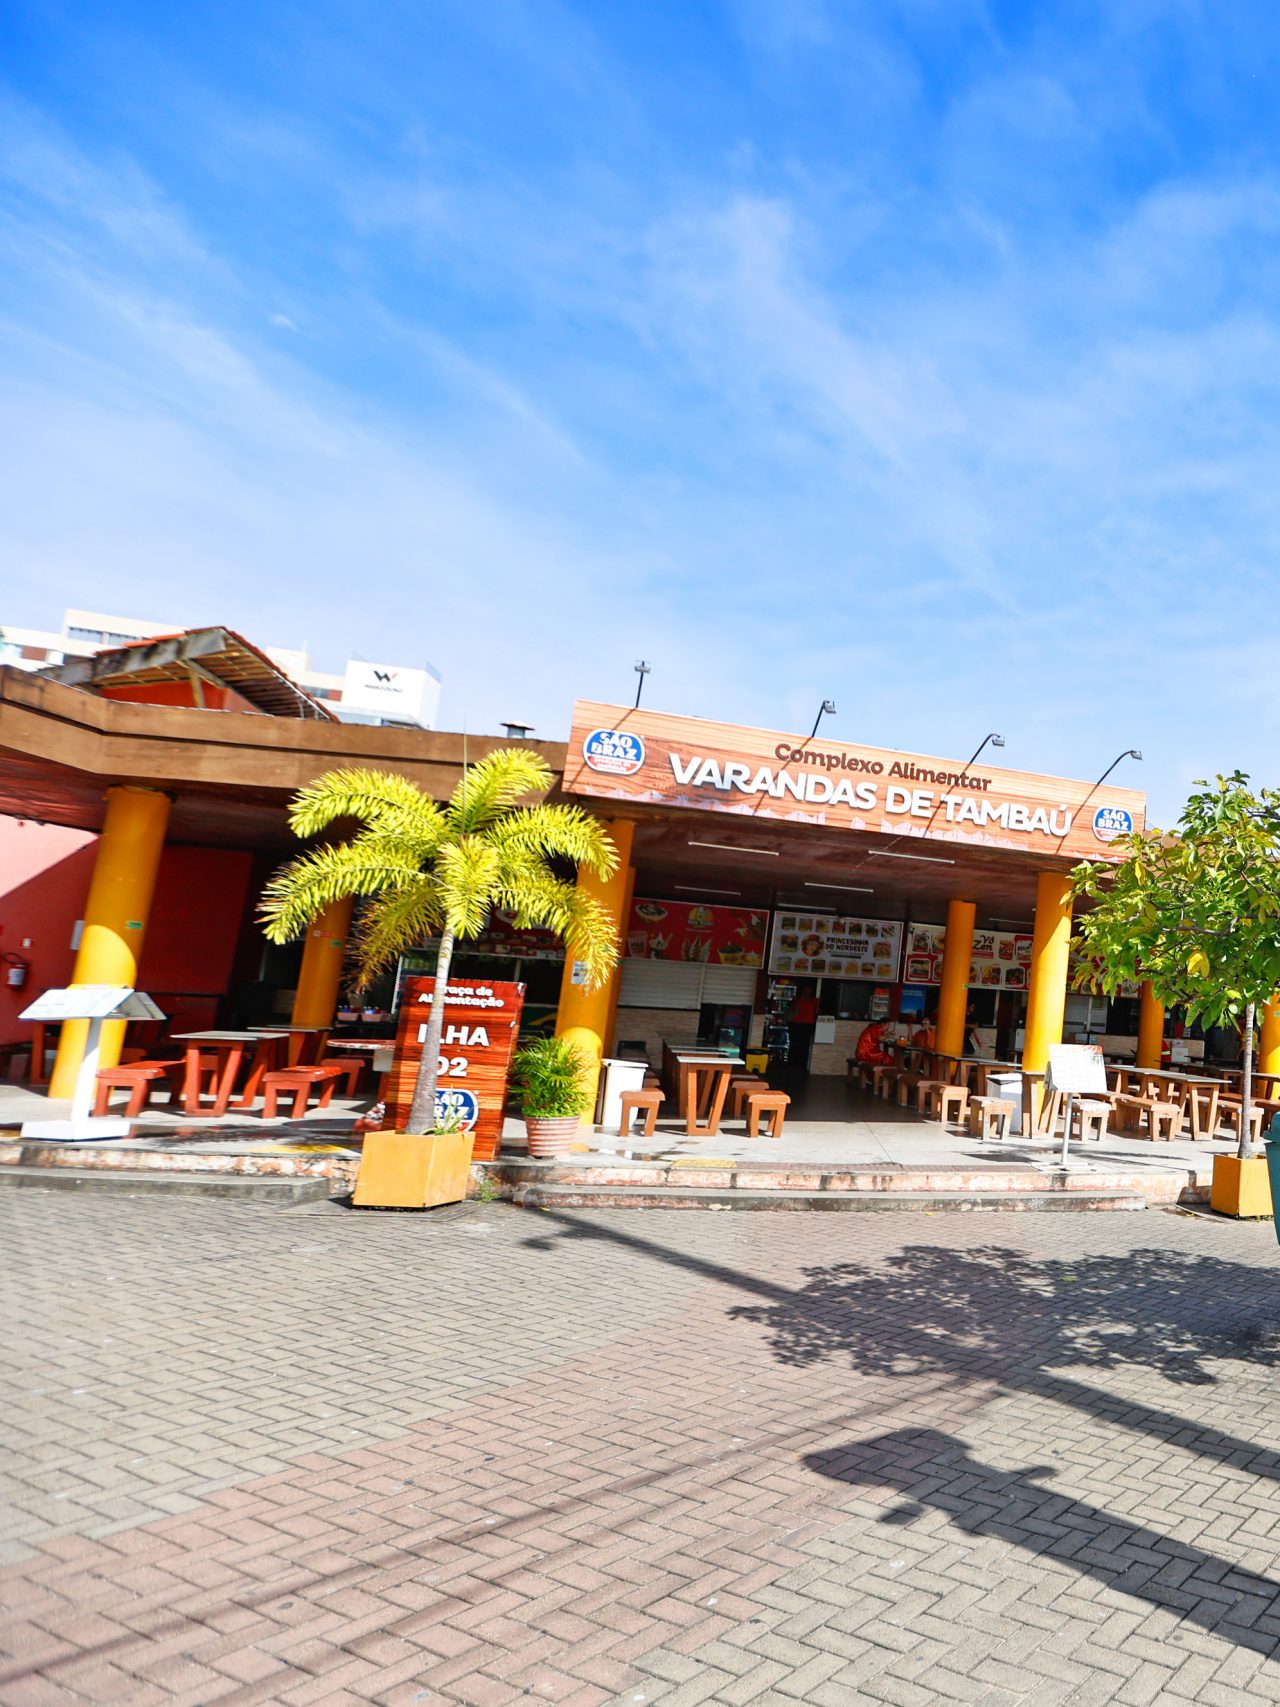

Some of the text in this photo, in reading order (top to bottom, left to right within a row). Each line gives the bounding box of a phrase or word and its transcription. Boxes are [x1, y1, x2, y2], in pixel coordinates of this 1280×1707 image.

[600, 732, 632, 748] SÃO
[590, 742, 637, 760] BRAZ
[775, 743, 992, 791] Complexo Alimentar
[669, 752, 1072, 837] VARANDAS DE TAMBAÚ
[1098, 818, 1128, 831] BRAZ
[443, 985, 493, 996] raça de
[417, 1023, 490, 1046] IHA
